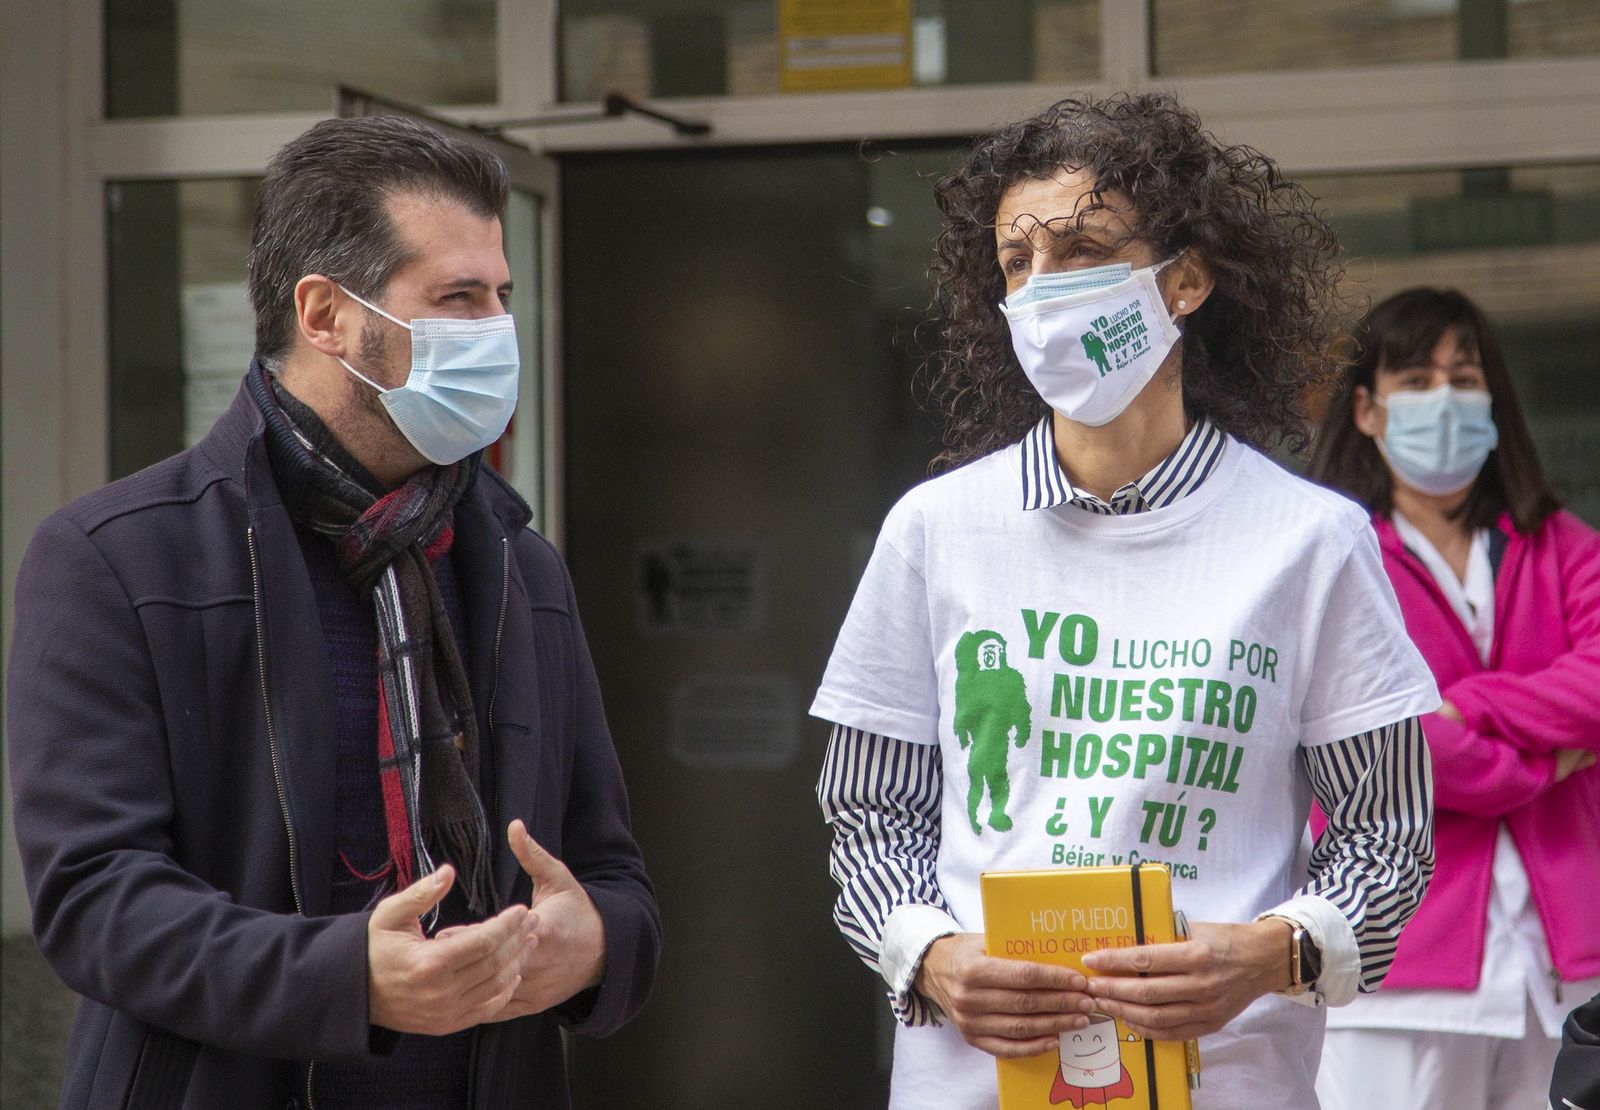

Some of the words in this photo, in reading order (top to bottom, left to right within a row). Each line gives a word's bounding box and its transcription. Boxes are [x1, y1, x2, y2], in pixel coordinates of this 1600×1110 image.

[1090, 315, 1108, 332] YO
[1108, 307, 1129, 324] LUCHO
[1129, 299, 1141, 311] POR
[1103, 310, 1143, 341] NUESTRO
[1107, 321, 1148, 353] HOSPITAL
[1021, 608, 1099, 667] YO
[1112, 638, 1212, 670] LUCHO
[1228, 639, 1279, 683] POR
[1050, 673, 1257, 734] NUESTRO
[1040, 730, 1244, 794] HOSPITAL
[1051, 843, 1105, 867] Béjar
[1031, 909, 1067, 933] HOY
[1072, 907, 1128, 932] PUEDO
[1006, 938, 1035, 955] CON
[1040, 939, 1058, 954] LO
[1063, 937, 1093, 953] QUE
[1096, 936, 1111, 951] ME
